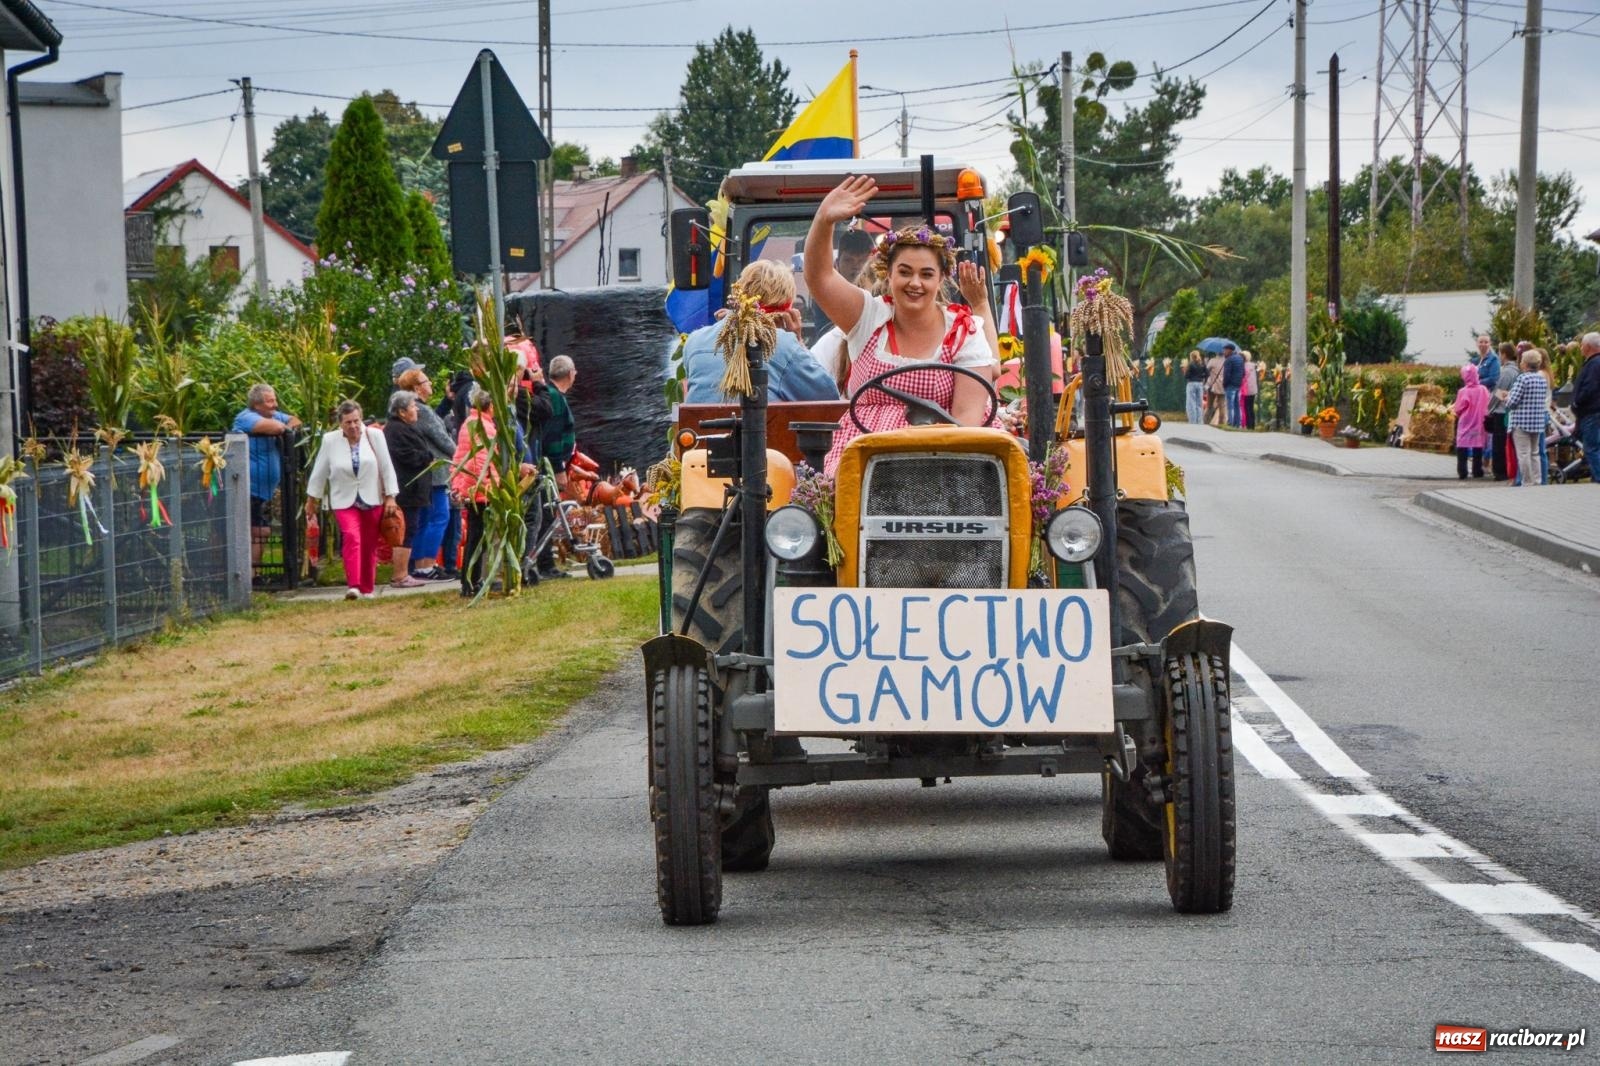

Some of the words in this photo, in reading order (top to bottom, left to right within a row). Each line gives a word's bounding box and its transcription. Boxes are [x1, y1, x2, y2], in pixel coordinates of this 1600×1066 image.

[882, 521, 988, 534] URSUS
[786, 594, 1092, 662] SOŁECTWO
[819, 658, 1066, 728] GAMÓW
